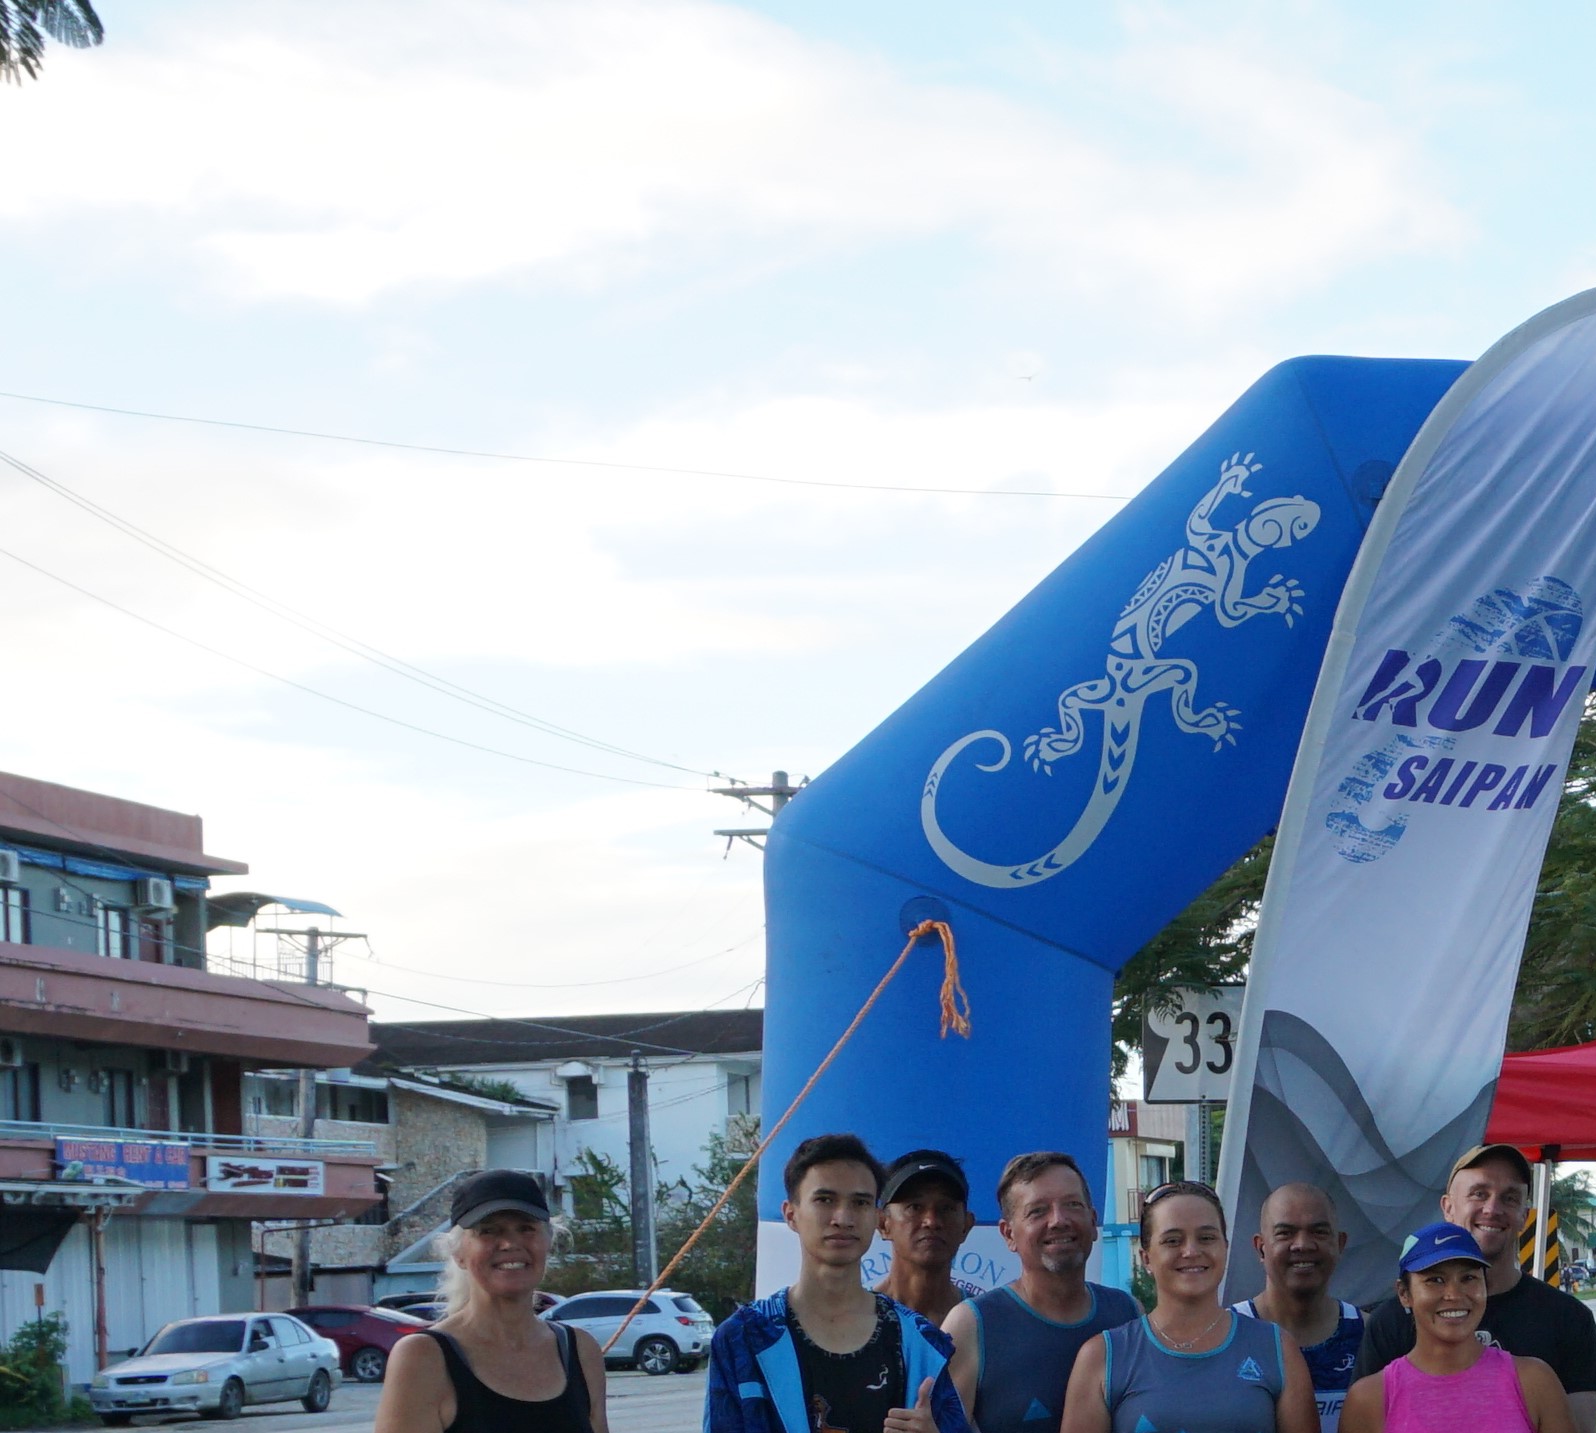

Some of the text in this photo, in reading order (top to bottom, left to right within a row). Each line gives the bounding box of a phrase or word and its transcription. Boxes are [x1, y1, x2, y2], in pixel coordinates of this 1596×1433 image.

[1351, 649, 1587, 738] RUN
[1383, 755, 1557, 811] SAIPAN
[1175, 1011, 1233, 1075] 33
